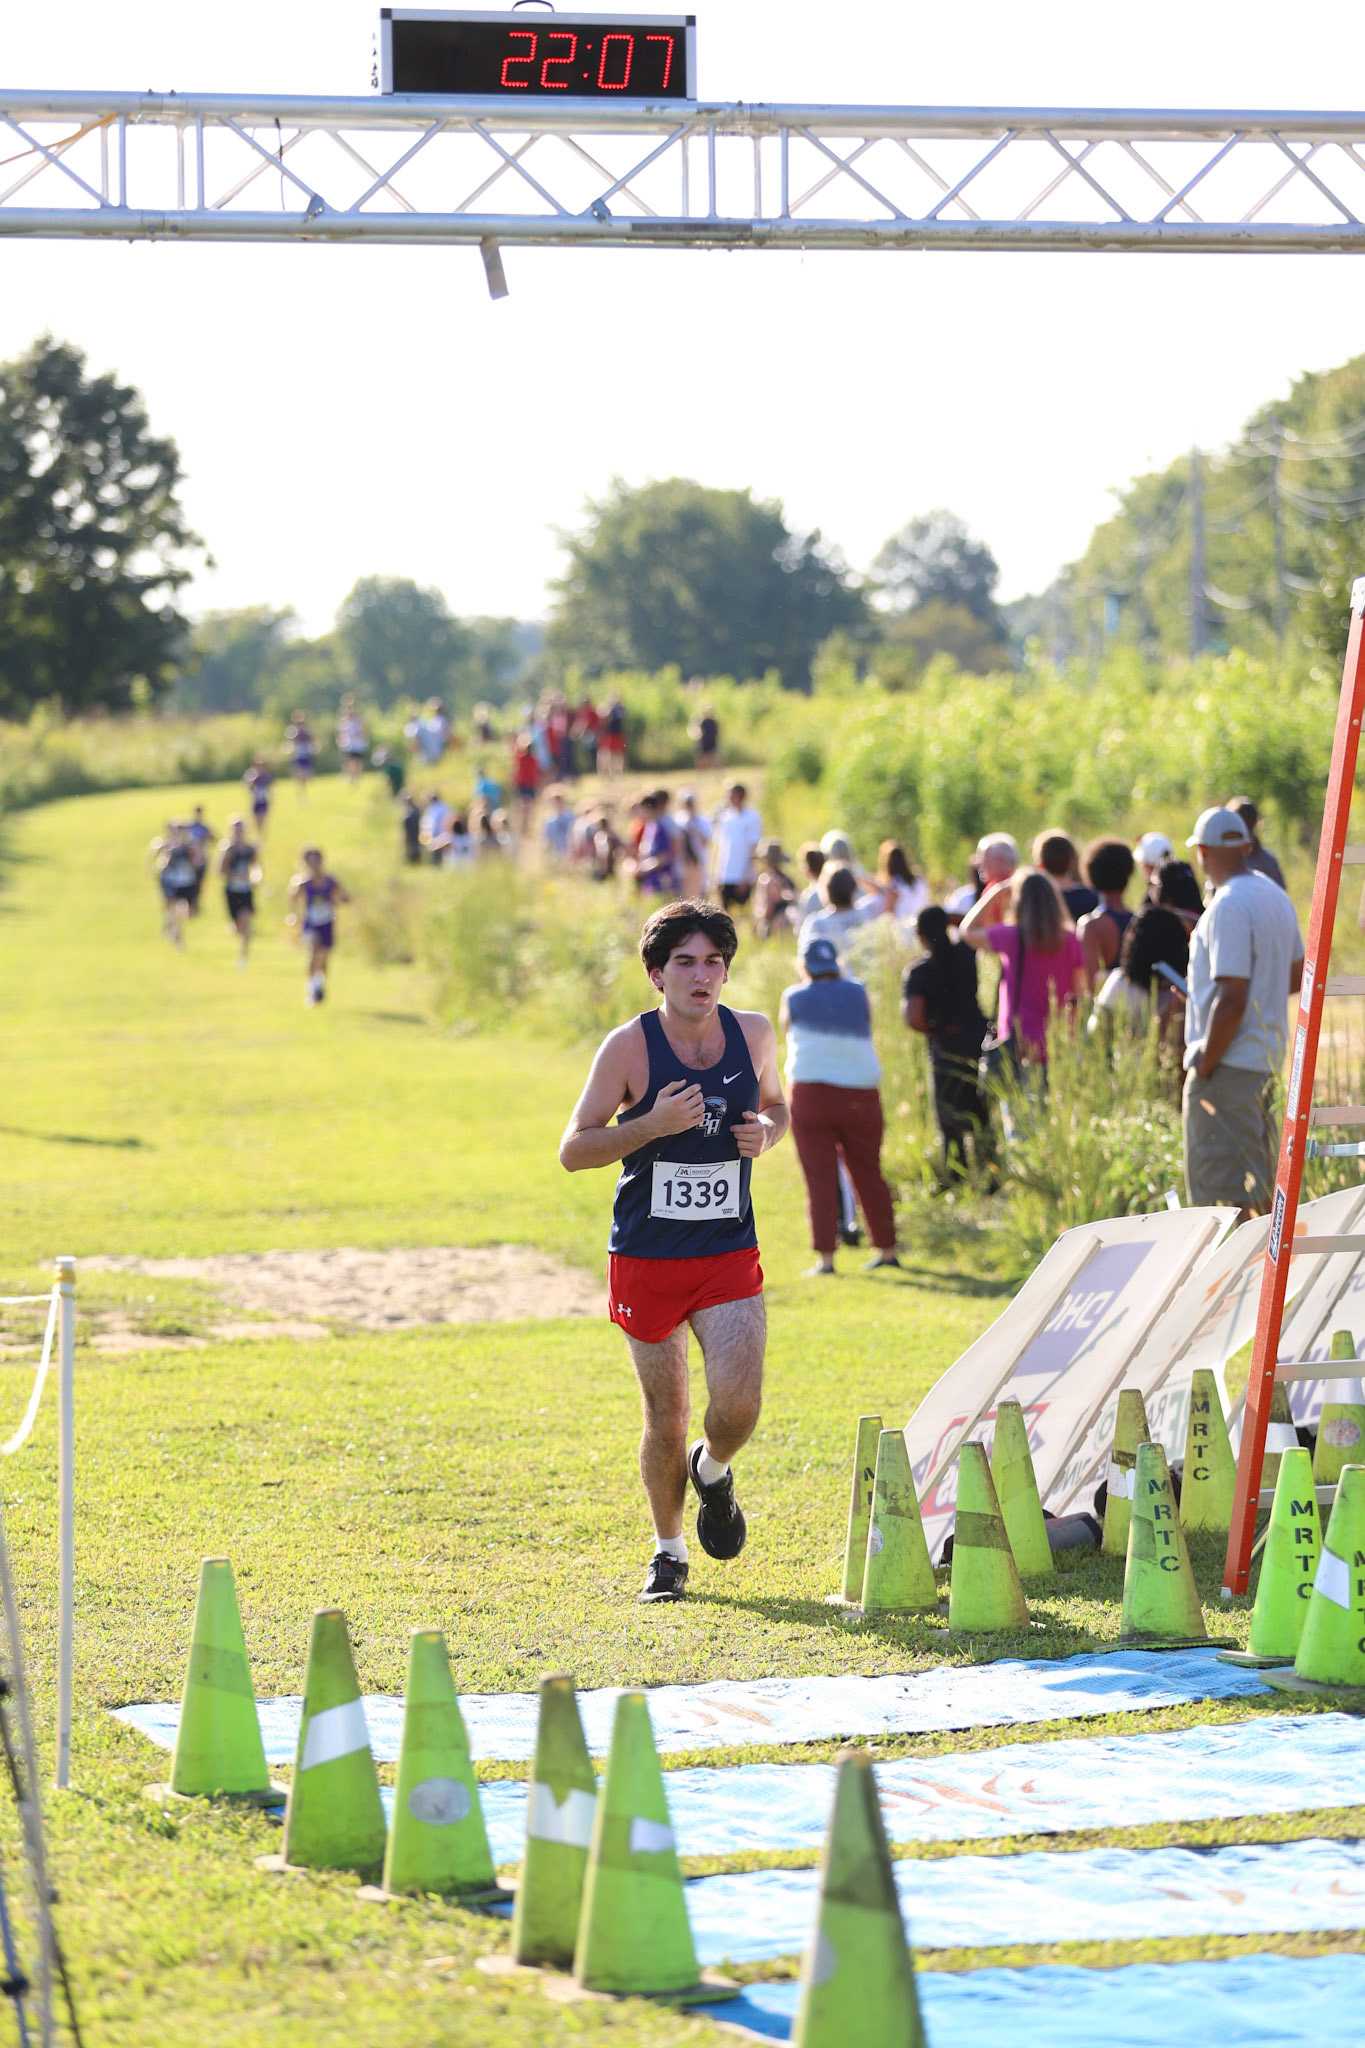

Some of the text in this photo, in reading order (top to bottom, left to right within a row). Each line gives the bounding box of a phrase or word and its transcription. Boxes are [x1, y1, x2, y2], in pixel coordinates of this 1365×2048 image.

[500, 31, 674, 90] 22:07
[663, 1179, 729, 1208] 1339
[1191, 1400, 1210, 1480] MRTC
[1148, 1479, 1180, 1571] MRTC
[1290, 1500, 1315, 1599] MRTC
